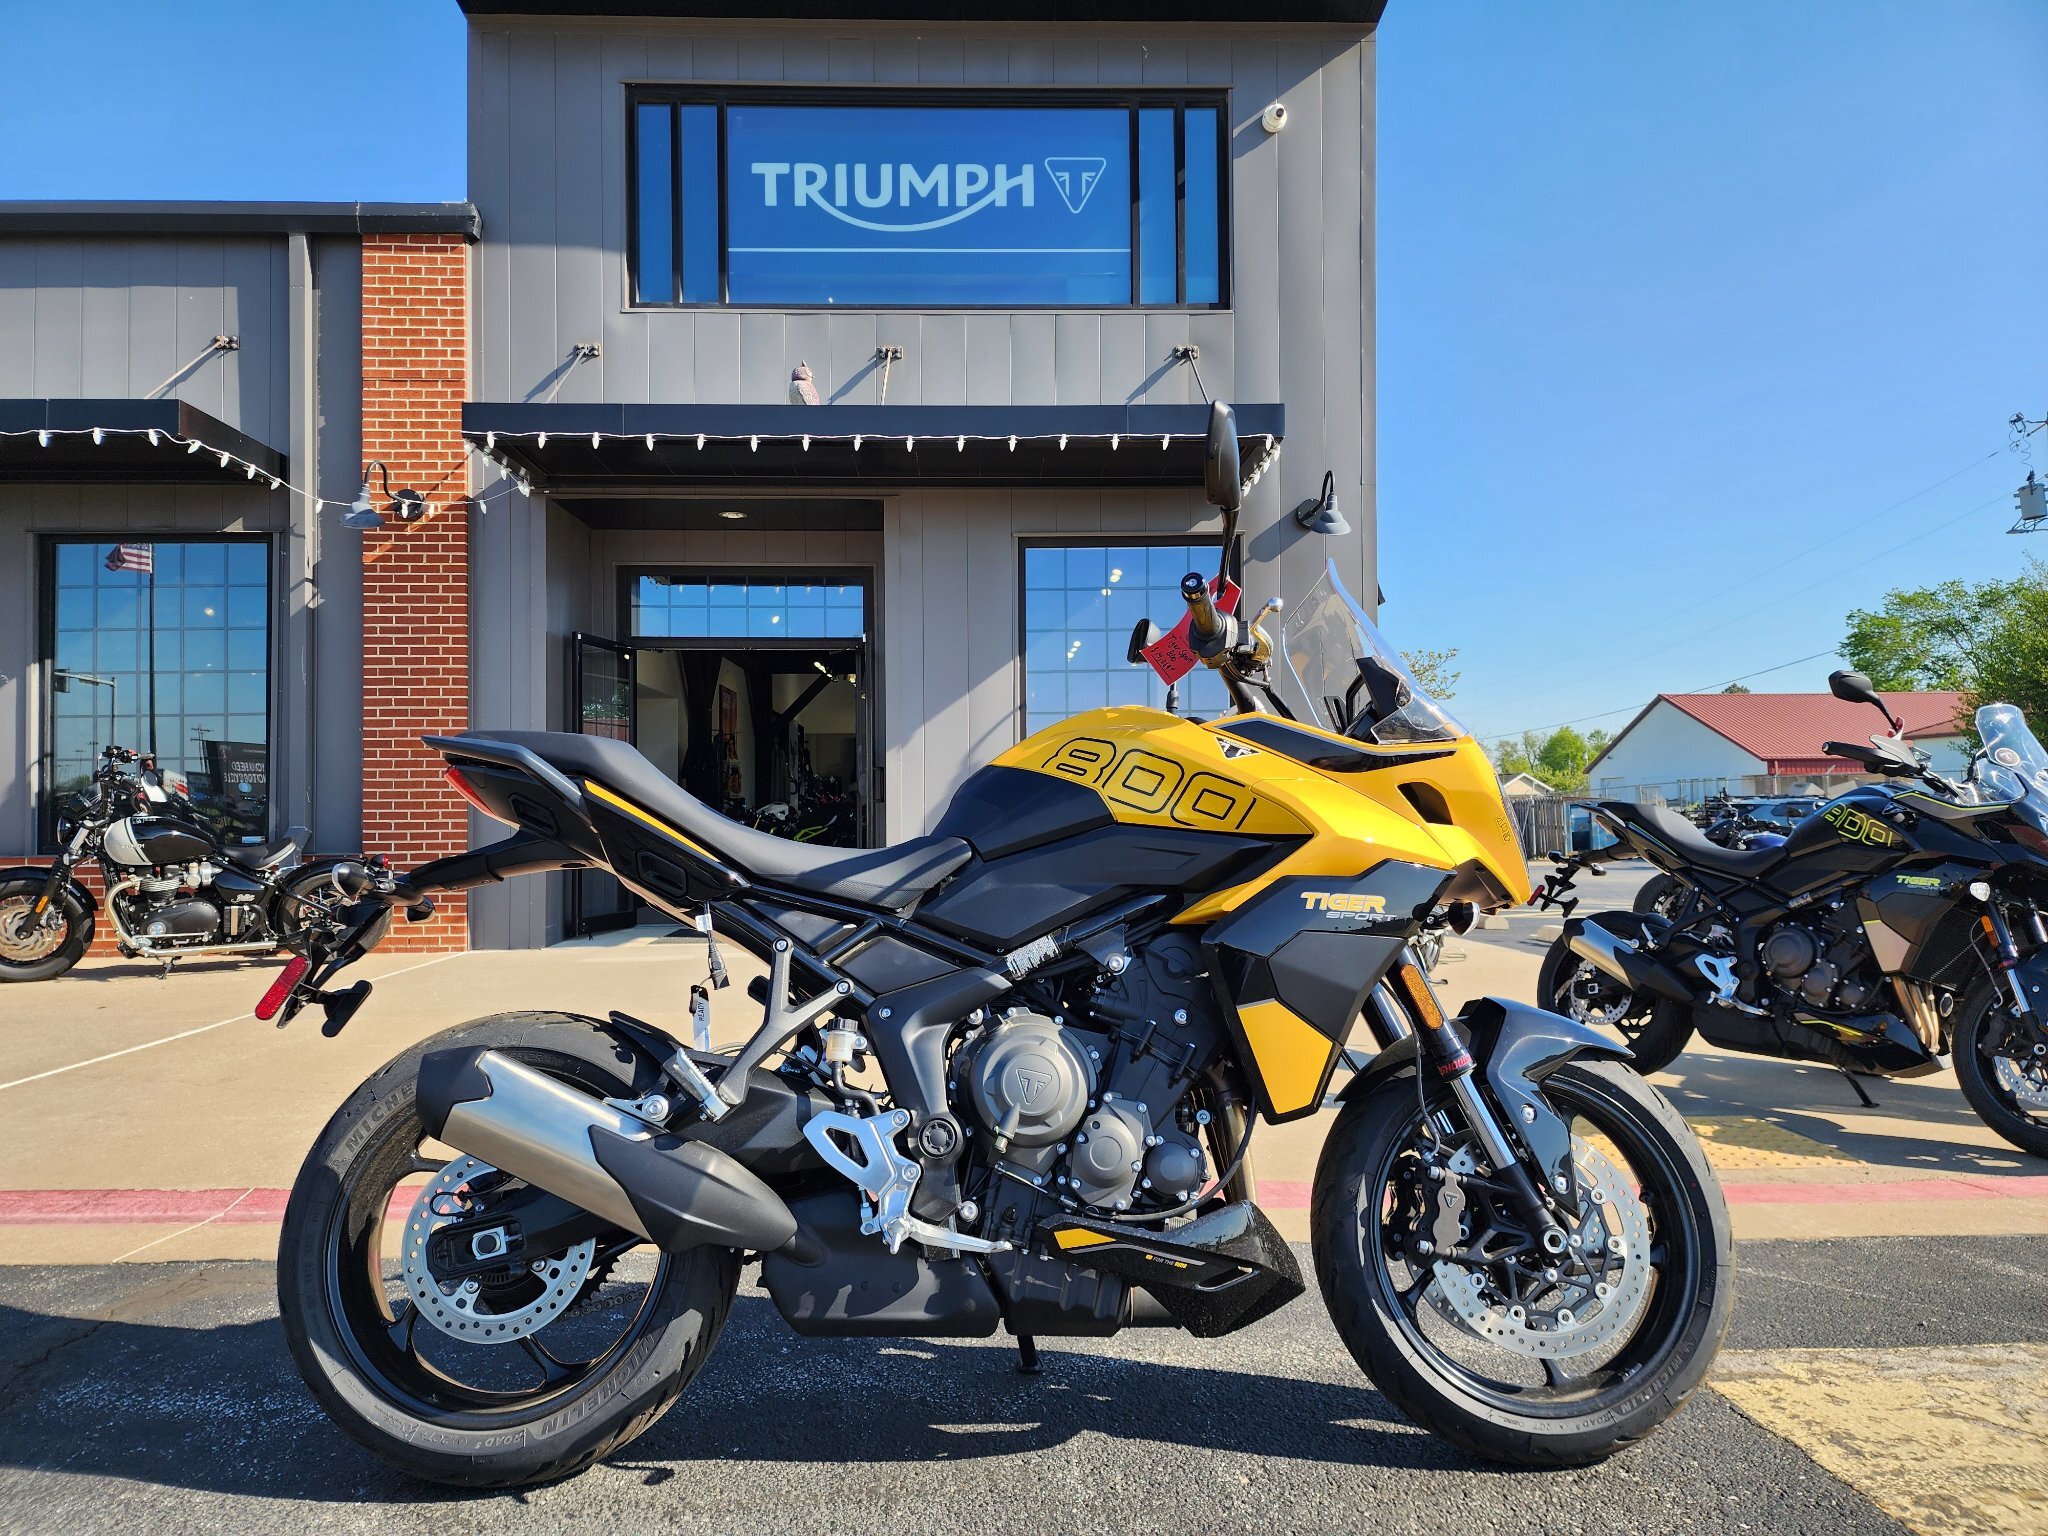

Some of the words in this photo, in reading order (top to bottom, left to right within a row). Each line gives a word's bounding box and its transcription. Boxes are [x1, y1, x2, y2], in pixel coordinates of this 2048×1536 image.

[751, 162, 1035, 232] TRIUMPH
[1041, 737, 1257, 830] 800
[1300, 892, 1387, 914] TIGER
[1896, 875, 1941, 887] TIGER
[1326, 911, 1397, 922] SPORT
[345, 1082, 417, 1153] MICHE
[540, 1333, 656, 1438] MICHELIN
[1621, 1354, 1683, 1414] MICHELIN
